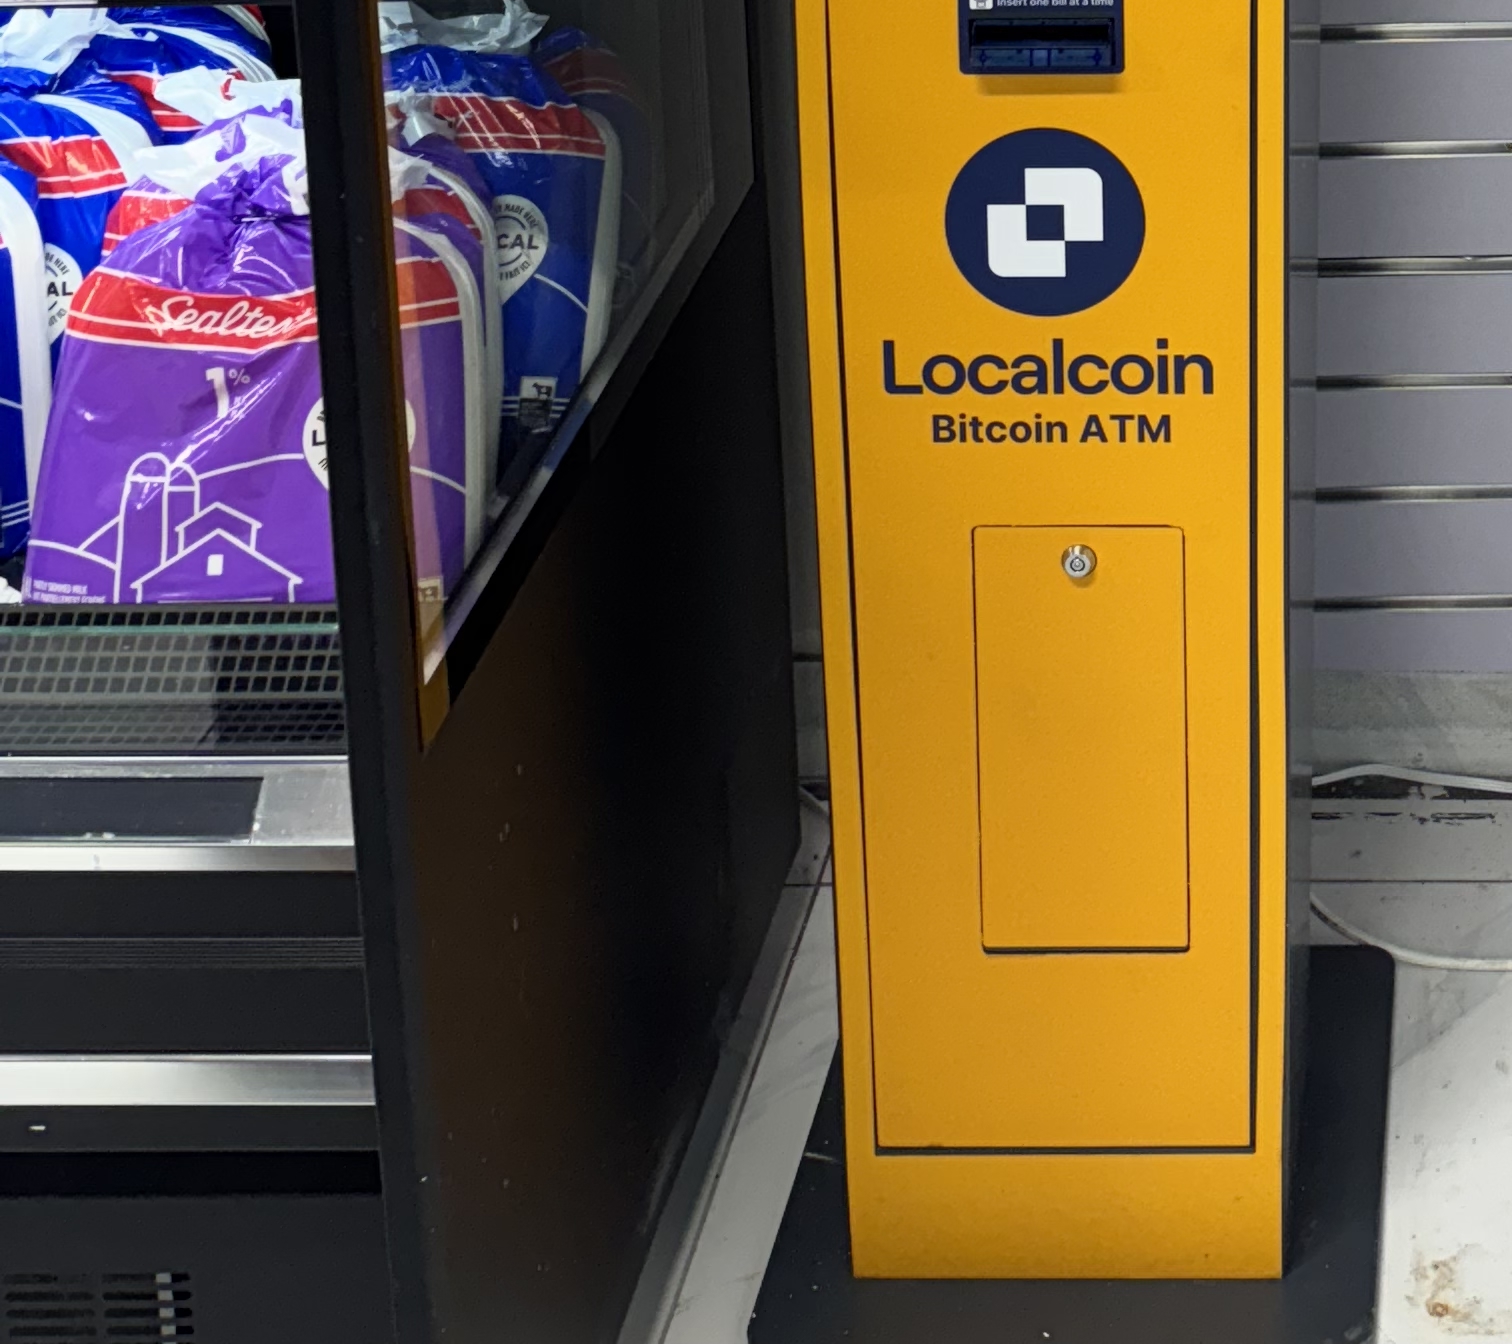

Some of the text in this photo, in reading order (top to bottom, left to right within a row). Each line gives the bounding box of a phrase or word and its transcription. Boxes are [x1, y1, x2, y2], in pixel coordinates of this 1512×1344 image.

[497, 234, 540, 250] CAL
[882, 338, 1215, 398] Localcoin
[932, 414, 1172, 445] Bitcoin ATM
